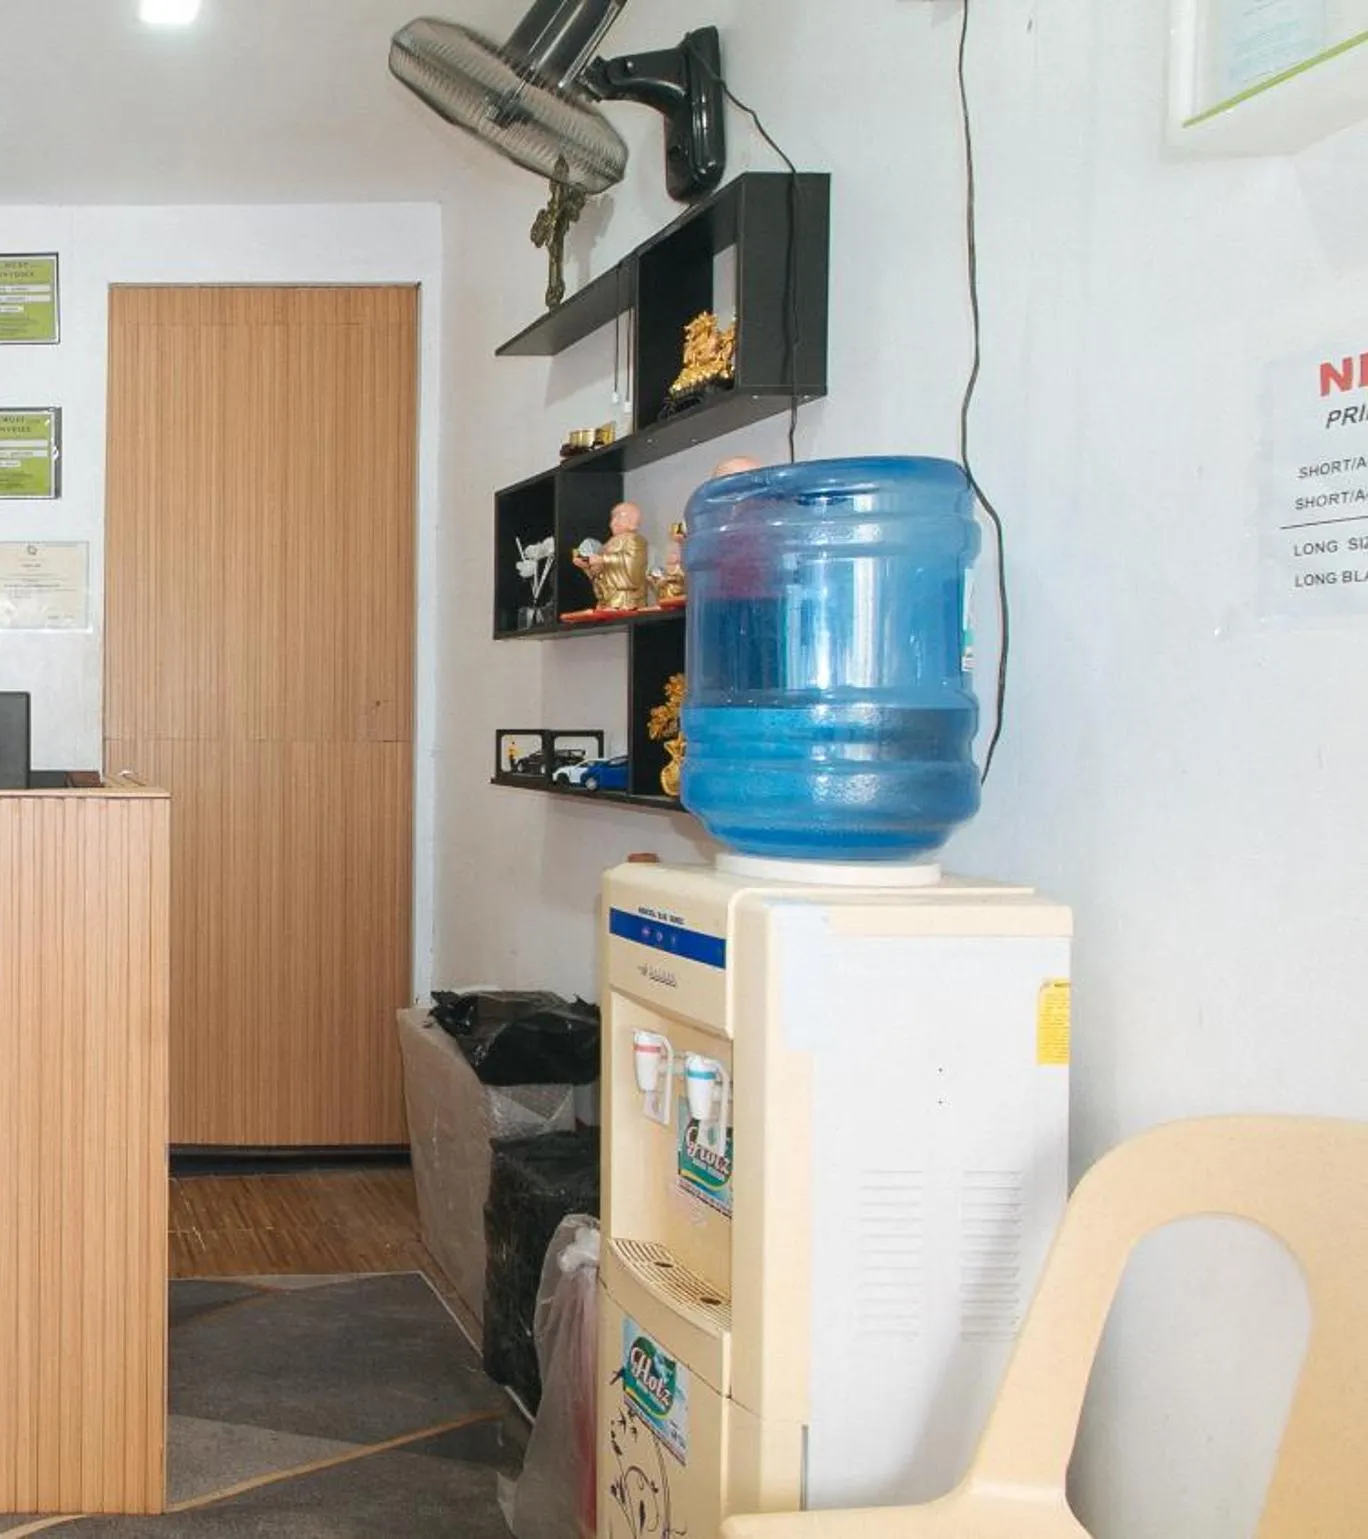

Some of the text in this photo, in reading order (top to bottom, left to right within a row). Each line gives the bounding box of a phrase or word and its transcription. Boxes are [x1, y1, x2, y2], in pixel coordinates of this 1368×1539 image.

[1320, 352, 1368, 397] N
[1326, 402, 1368, 429] PRI
[1296, 456, 1368, 479] SHORT/A
[1294, 489, 1368, 510] SHORT/A
[1294, 540, 1338, 557] LONG
[1295, 572, 1337, 588] LONG
